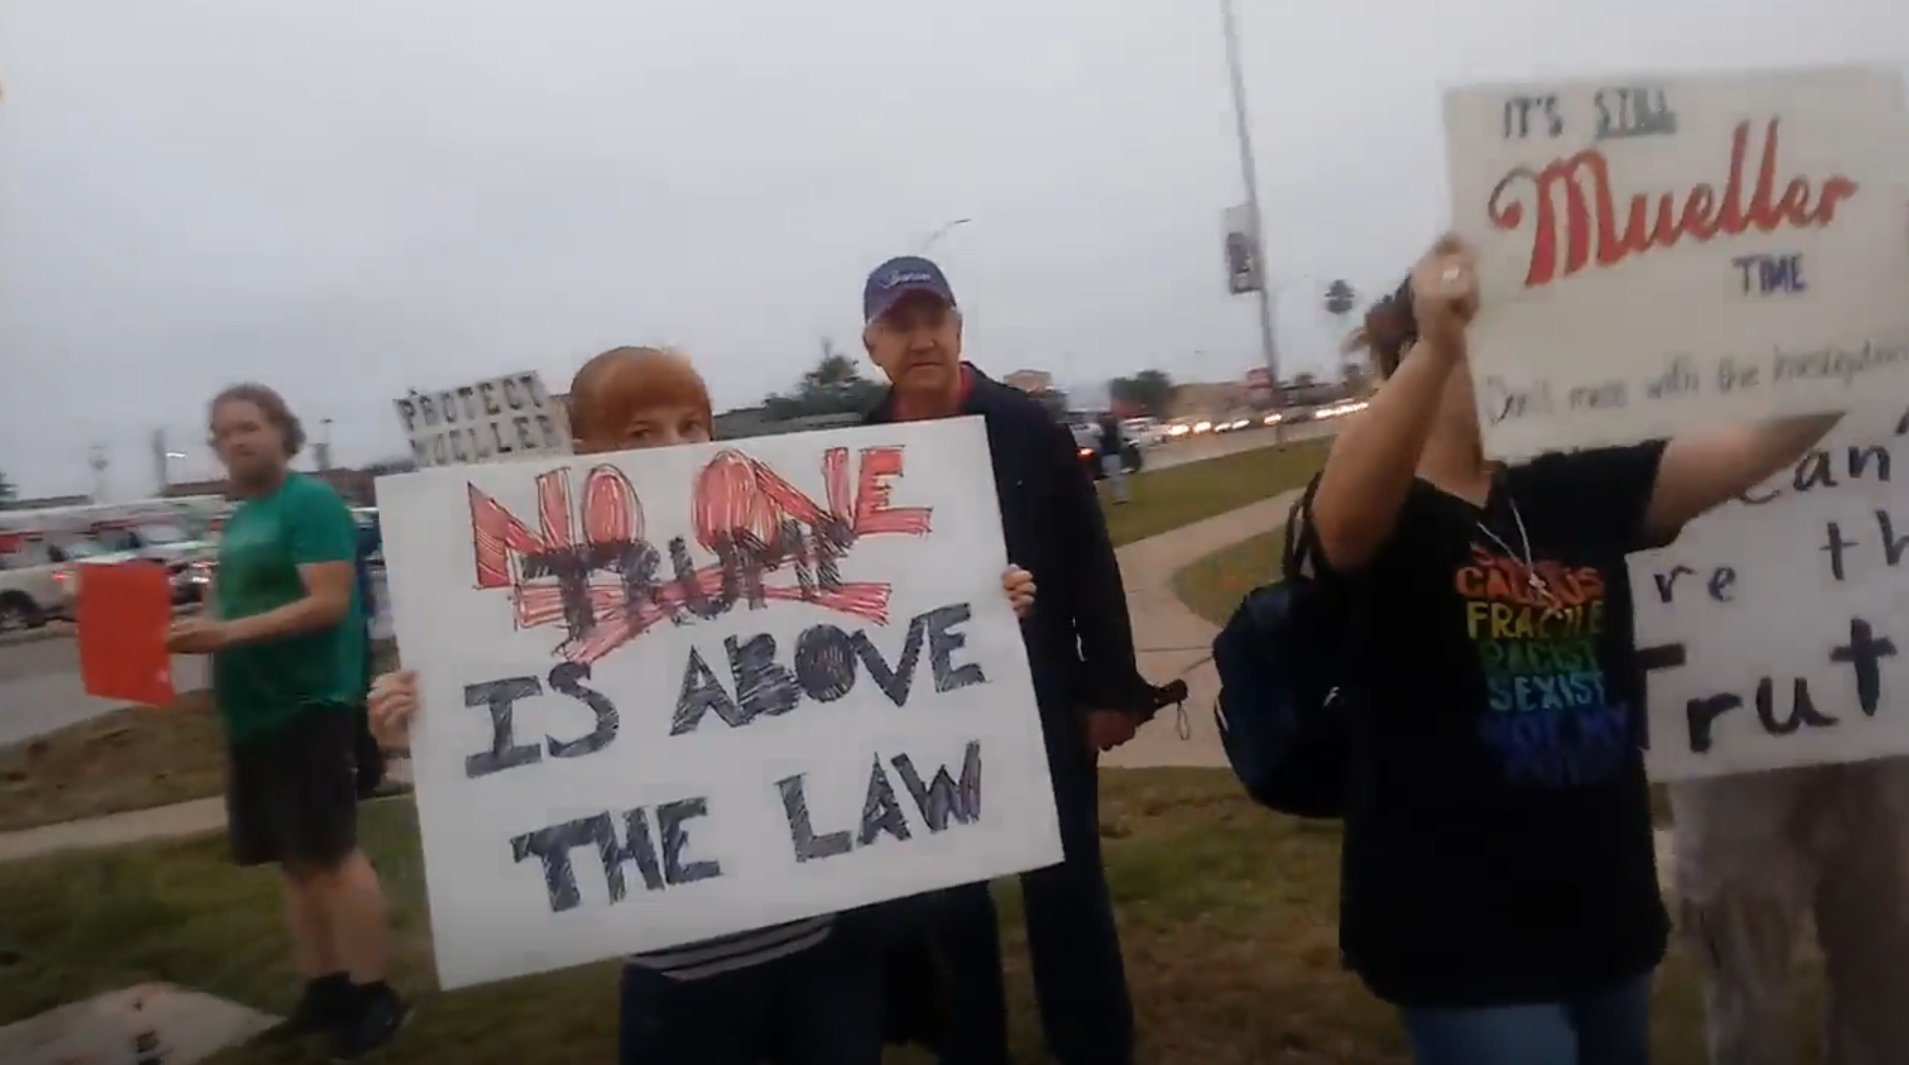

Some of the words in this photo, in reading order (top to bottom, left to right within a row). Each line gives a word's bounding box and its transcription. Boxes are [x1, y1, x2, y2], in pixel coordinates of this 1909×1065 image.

[1504, 93, 1563, 139] IT'S
[1595, 86, 1678, 139] STILL
[1488, 113, 1858, 288] Mueller
[1732, 250, 1807, 297] TIME
[394, 372, 543, 432] PROTECT
[466, 463, 645, 590] NO
[690, 444, 934, 554] ONE
[463, 658, 620, 779] IS
[668, 601, 994, 737] ABOVE
[1487, 670, 1606, 712] SEXIST
[509, 795, 724, 913] THE
[773, 739, 983, 863] LAW
